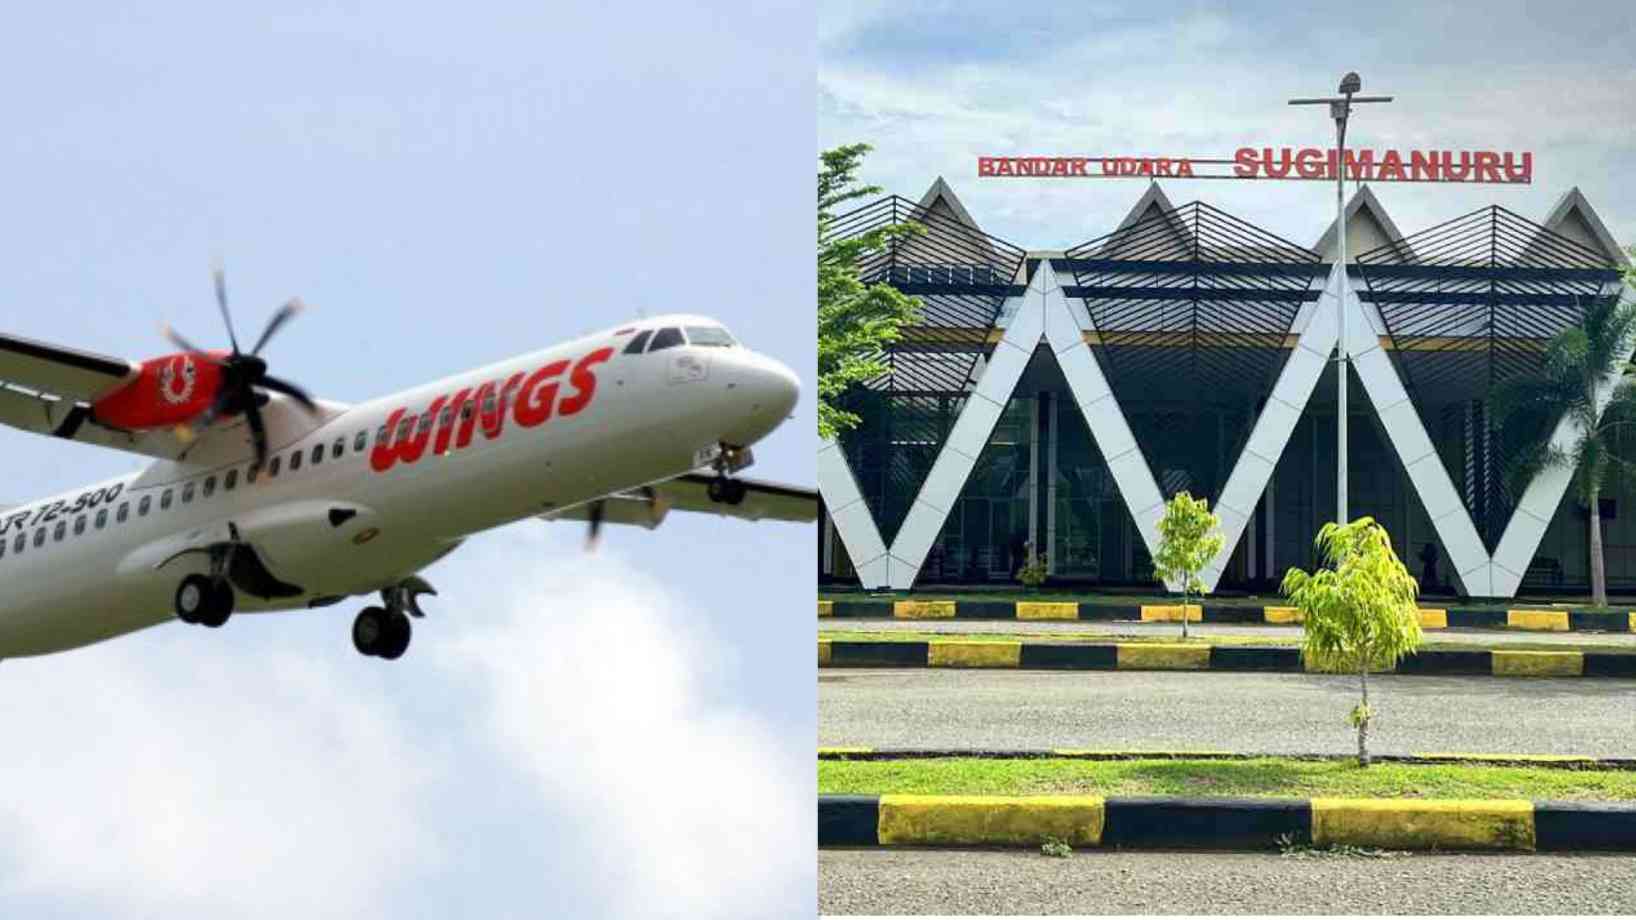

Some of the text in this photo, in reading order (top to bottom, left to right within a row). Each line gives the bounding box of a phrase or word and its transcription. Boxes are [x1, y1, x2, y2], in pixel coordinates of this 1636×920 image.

[978, 147, 1532, 183] BANDAR UDARA SUGIMANURU
[370, 347, 615, 473] WINGS
